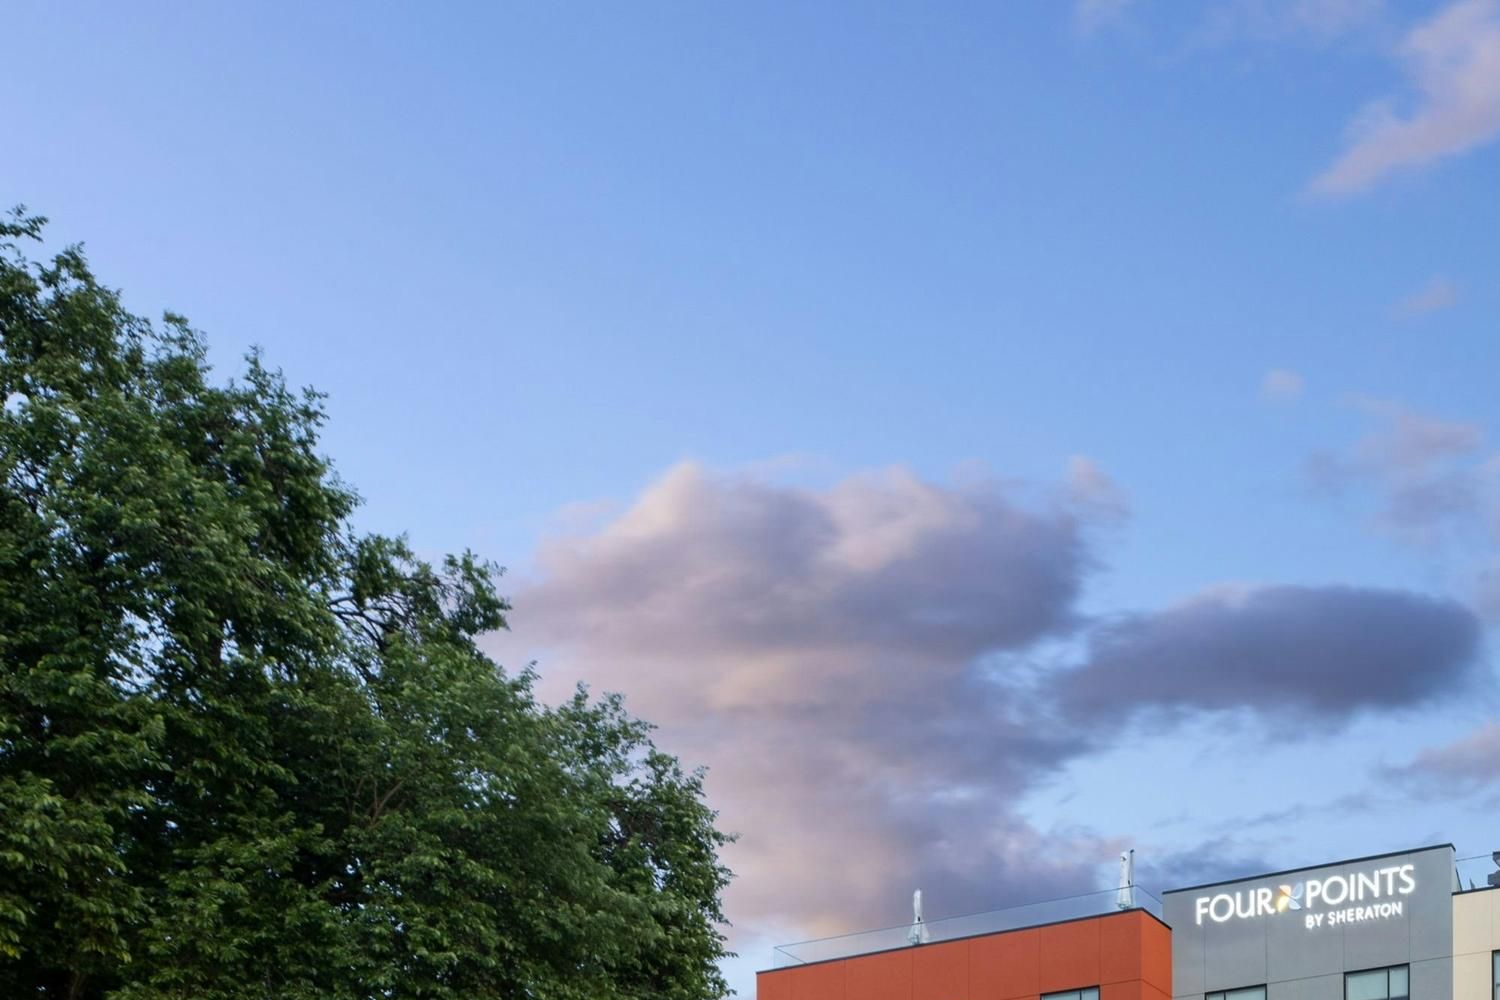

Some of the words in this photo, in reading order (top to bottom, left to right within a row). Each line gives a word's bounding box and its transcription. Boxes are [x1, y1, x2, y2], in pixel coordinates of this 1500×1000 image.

[1195, 887, 1275, 925] FOUR
[1305, 864, 1416, 908] POINTS
[1305, 912, 1323, 928] BY
[1327, 901, 1402, 926] SHERATON
